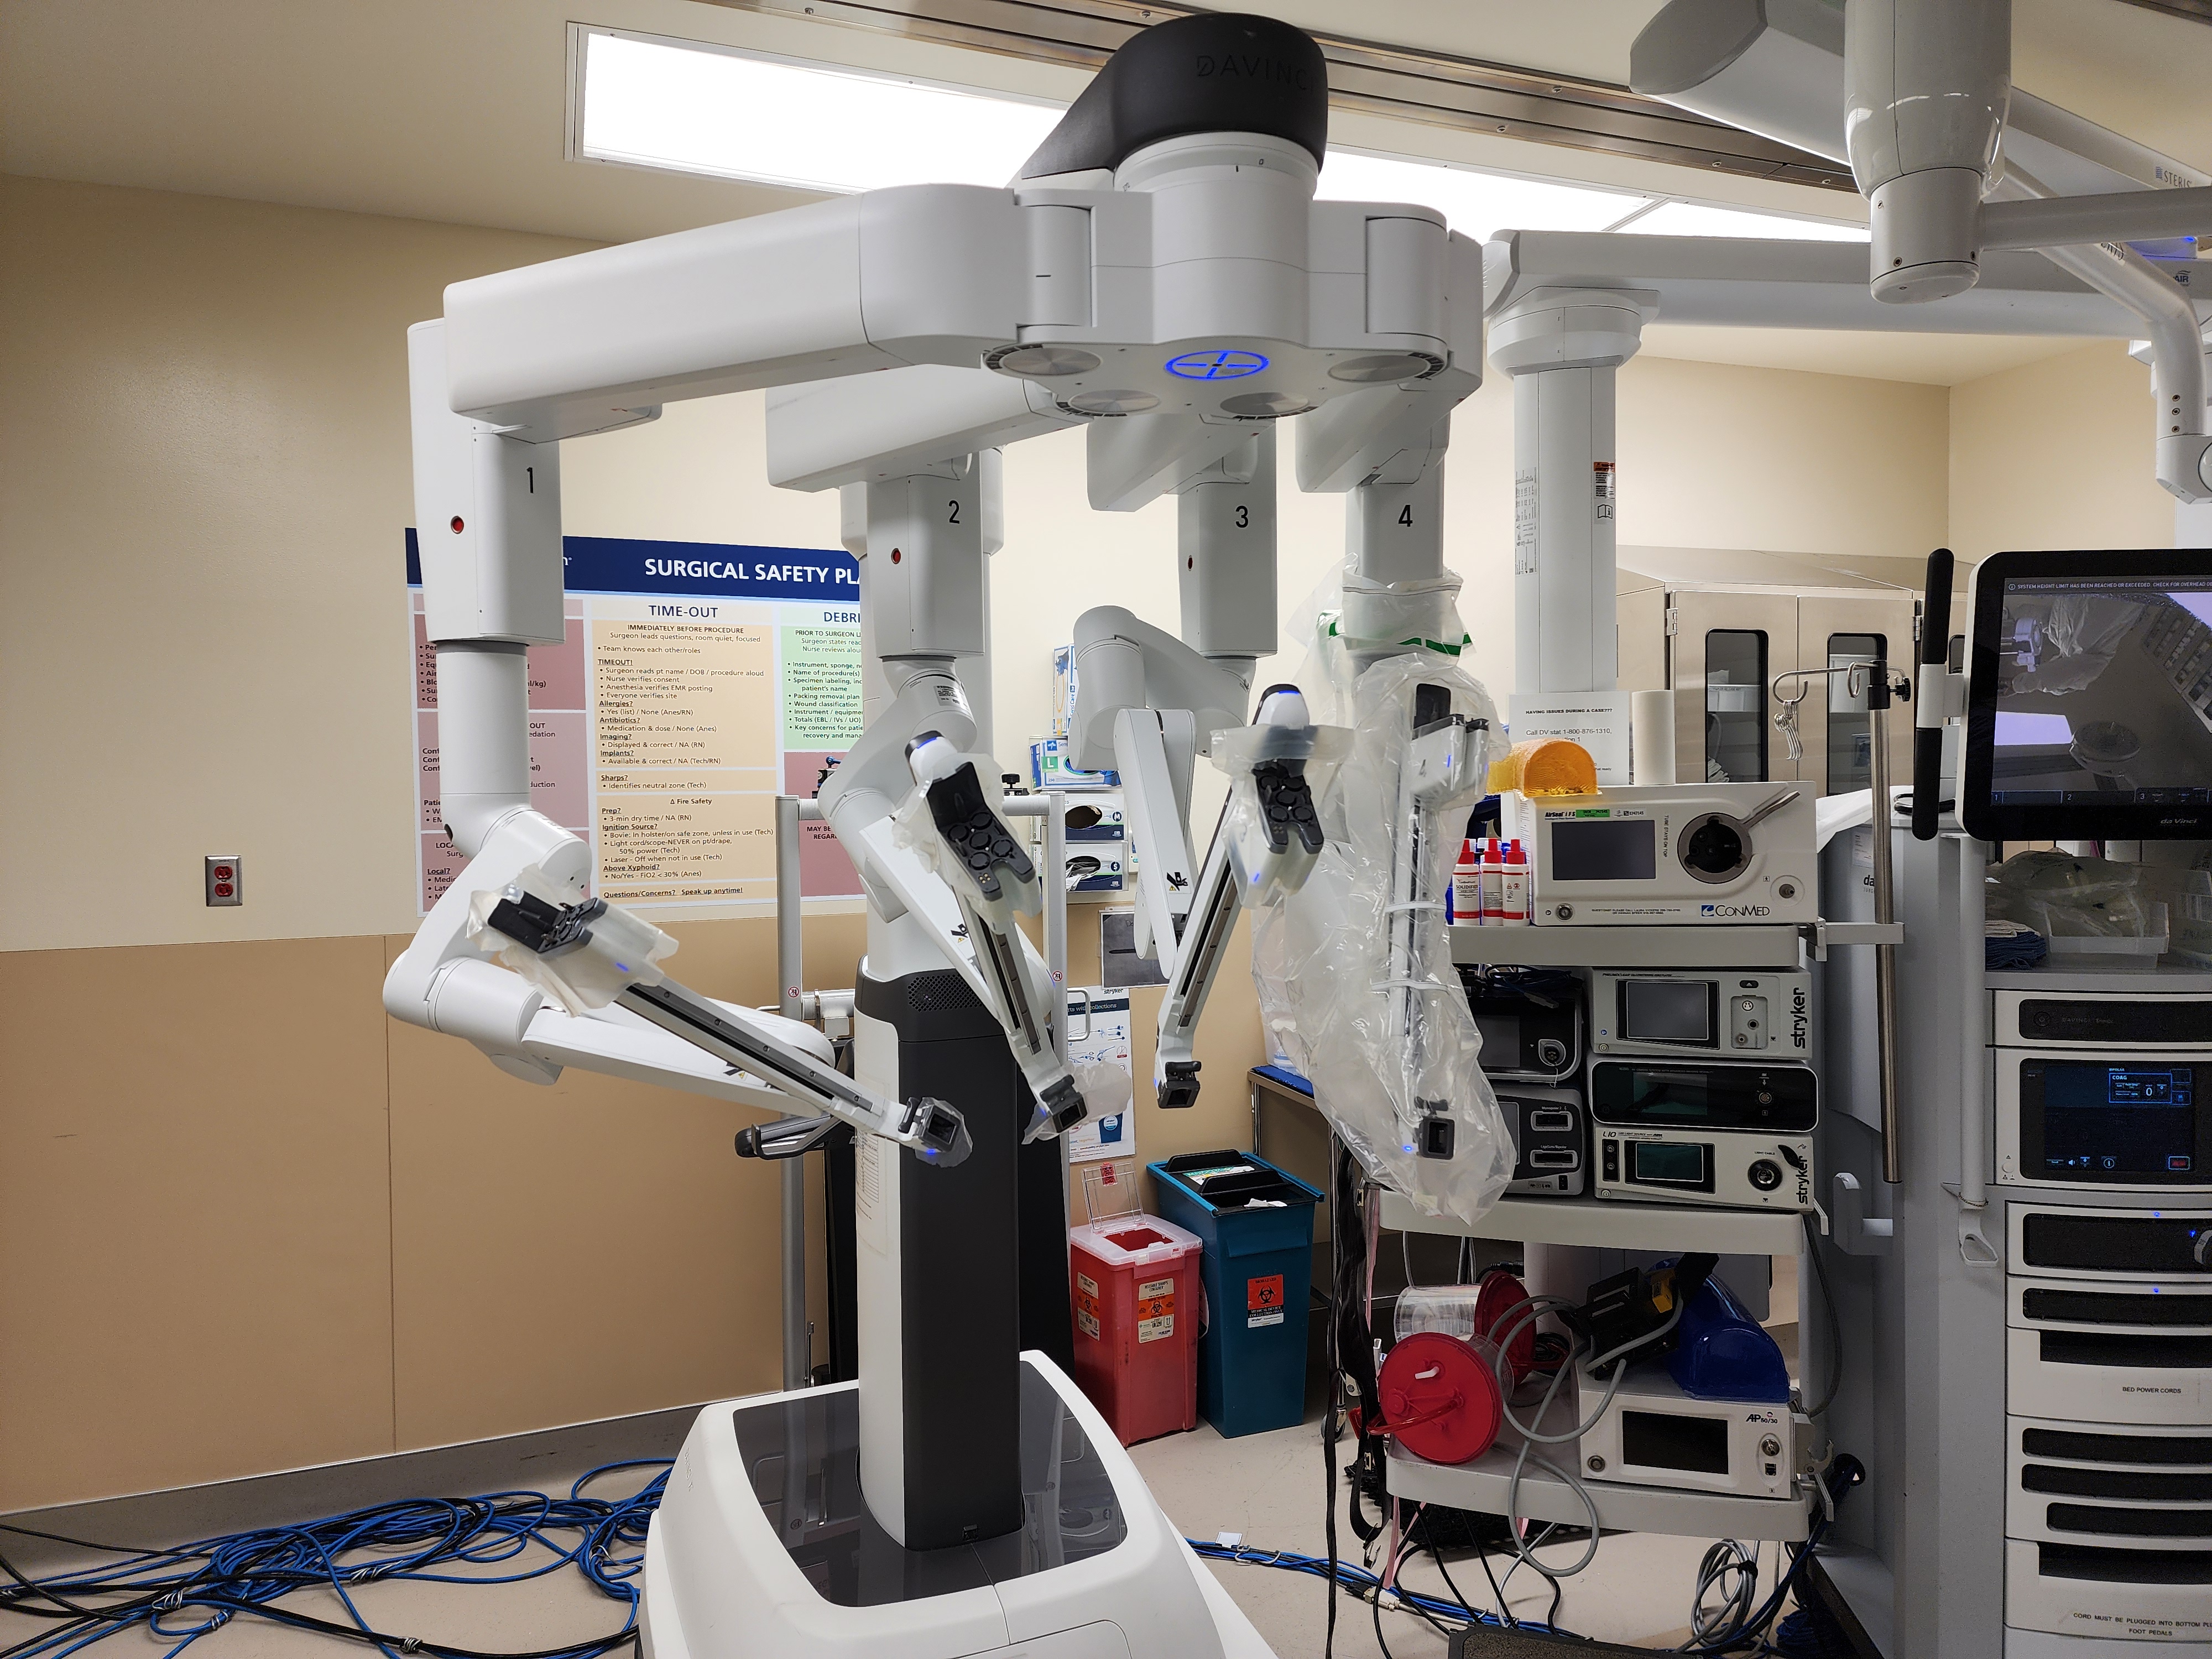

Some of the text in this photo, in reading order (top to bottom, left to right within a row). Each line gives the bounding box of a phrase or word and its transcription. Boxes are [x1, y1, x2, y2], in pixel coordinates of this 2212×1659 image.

[526, 467, 533, 493] 1
[949, 500, 959, 524] 2
[1235, 505, 1249, 528] 3
[1398, 504, 1413, 527] 4
[645, 559, 860, 585] SURGICAL SAFETY PL
[649, 605, 718, 618] TIME-OUT
[610, 632, 639, 640] Surgeon
[821, 669, 860, 677] procedure(s)
[687, 685, 713, 693] posting
[1047, 757, 1054, 768] L
[691, 798, 712, 806] Safety
[627, 864, 660, 872] Xyphoid?
[604, 890, 675, 899] Questions/Concerns?
[1790, 987, 1807, 1049] stryker
[2146, 1087, 2152, 1096] 0
[1795, 1155, 1810, 1205] stryker
